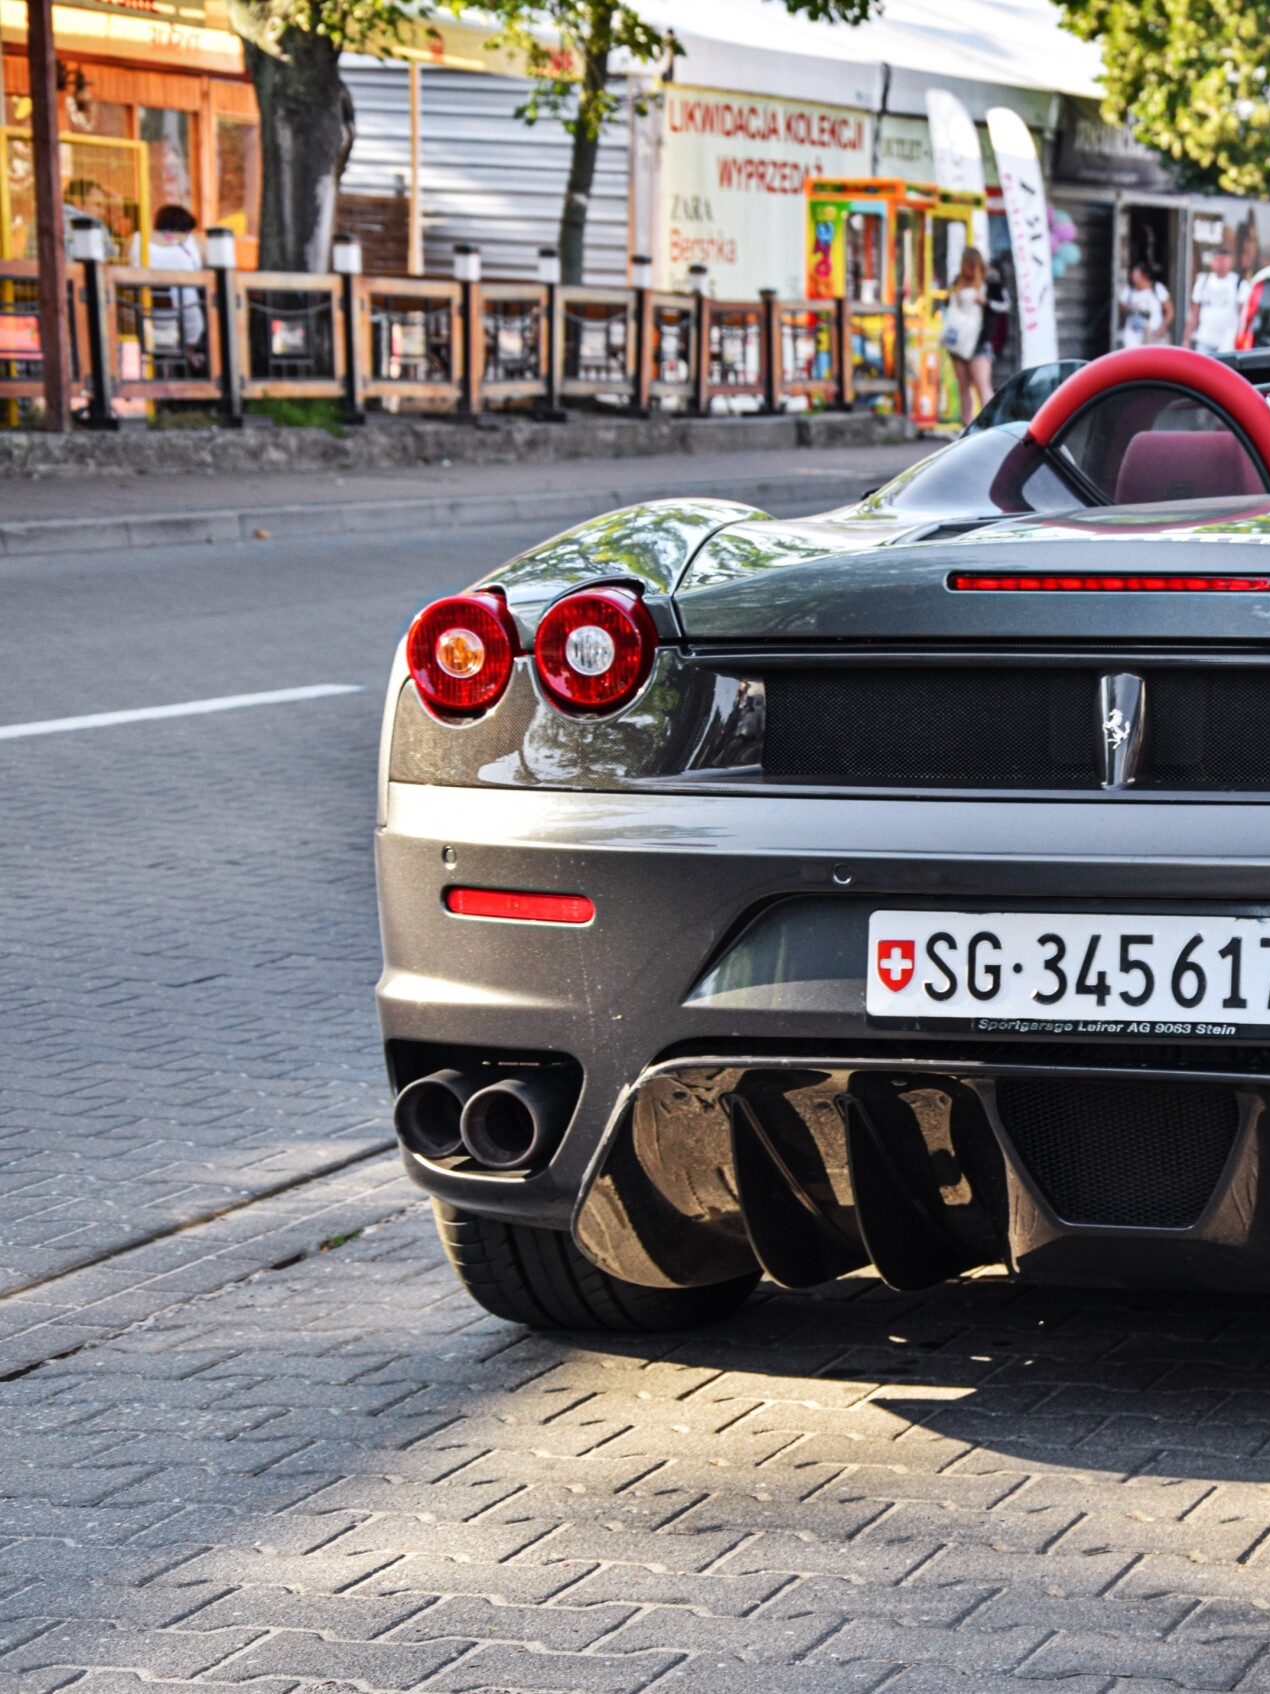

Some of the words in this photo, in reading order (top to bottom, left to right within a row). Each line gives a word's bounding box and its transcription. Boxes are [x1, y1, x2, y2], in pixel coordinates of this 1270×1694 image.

[669, 98, 780, 142] LIKWIDACJA
[784, 112, 865, 152] KOLEKCJI
[670, 228, 736, 264] Bershka
[978, 1017, 1073, 1034] Sportgarage
[1127, 1022, 1151, 1034] AG
[1154, 1023, 1191, 1035] 9063
[1195, 1023, 1236, 1036] Stein
